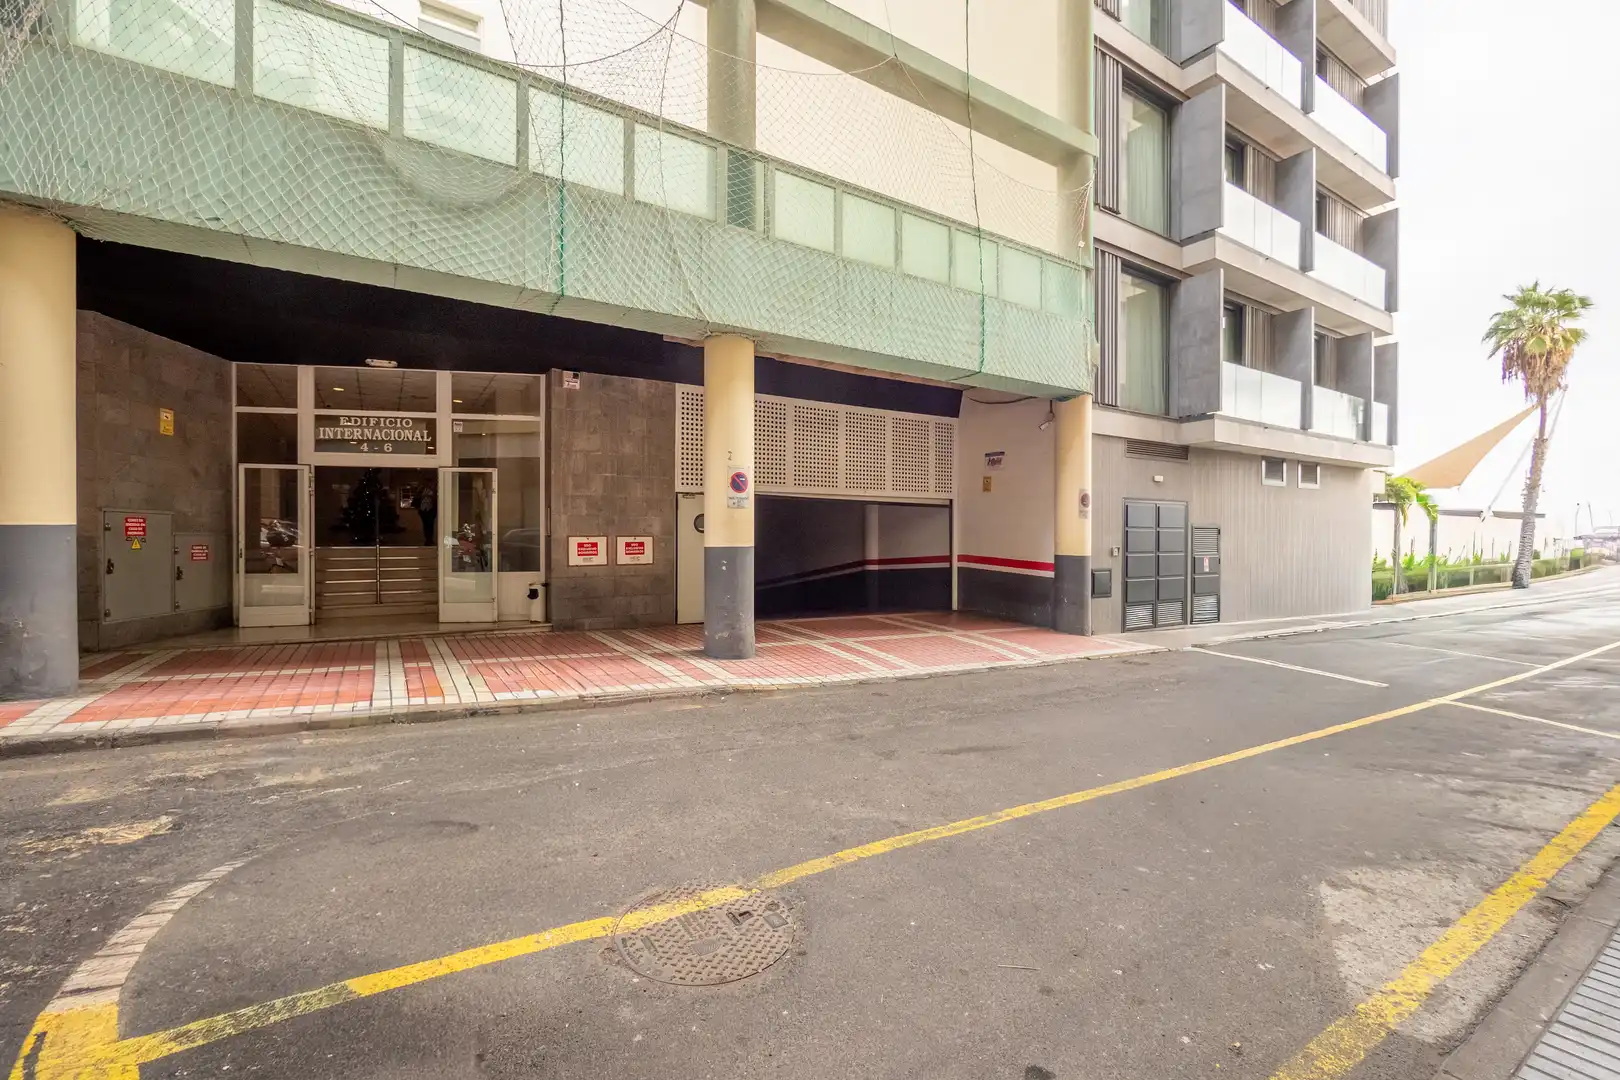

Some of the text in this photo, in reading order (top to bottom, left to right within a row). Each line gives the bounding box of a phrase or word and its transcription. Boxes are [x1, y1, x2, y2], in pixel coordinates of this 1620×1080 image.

[340, 416, 413, 428] EDIFICIO
[319, 427, 432, 442] INTERNACIONAL
[360, 442, 369, 452] 4
[383, 443, 393, 453] 6
